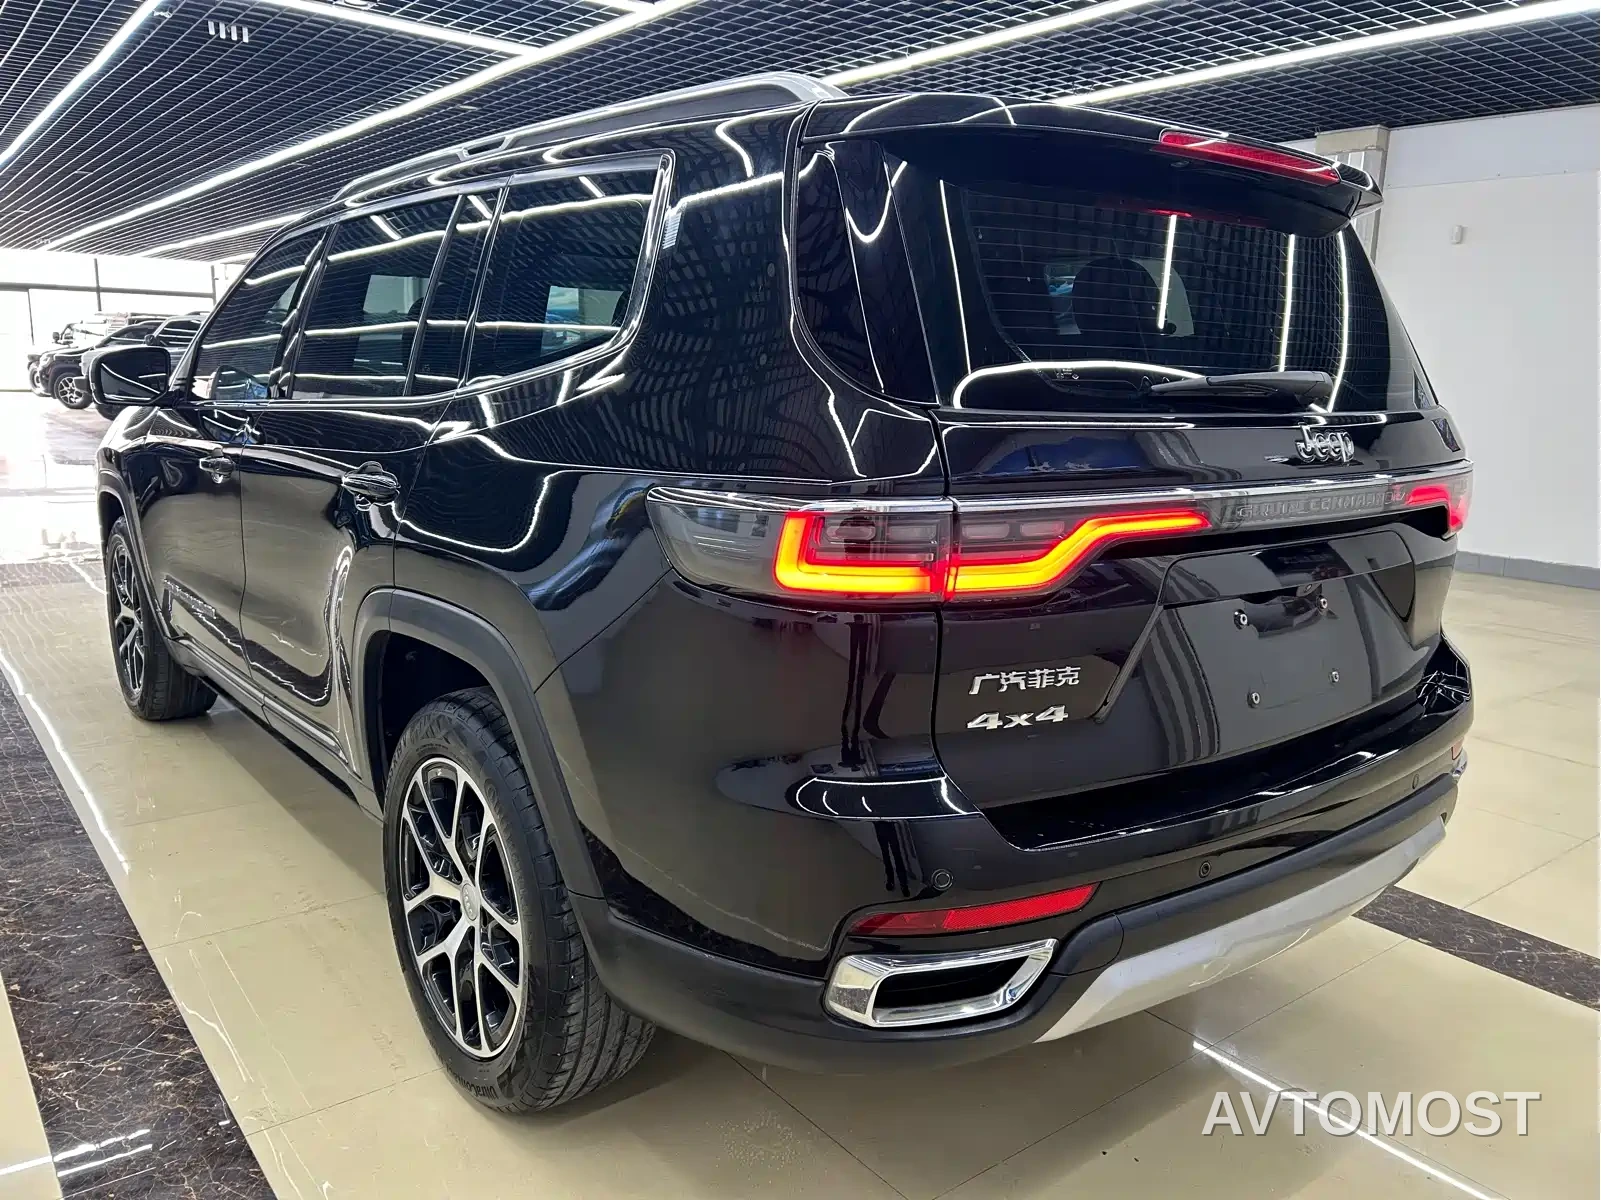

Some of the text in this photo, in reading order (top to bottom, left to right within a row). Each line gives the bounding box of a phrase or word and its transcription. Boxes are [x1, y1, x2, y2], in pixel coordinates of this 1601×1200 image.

[1296, 422, 1355, 463] Jeep
[968, 666, 1081, 695] 广汽菲克
[967, 705, 1069, 730] 4x4
